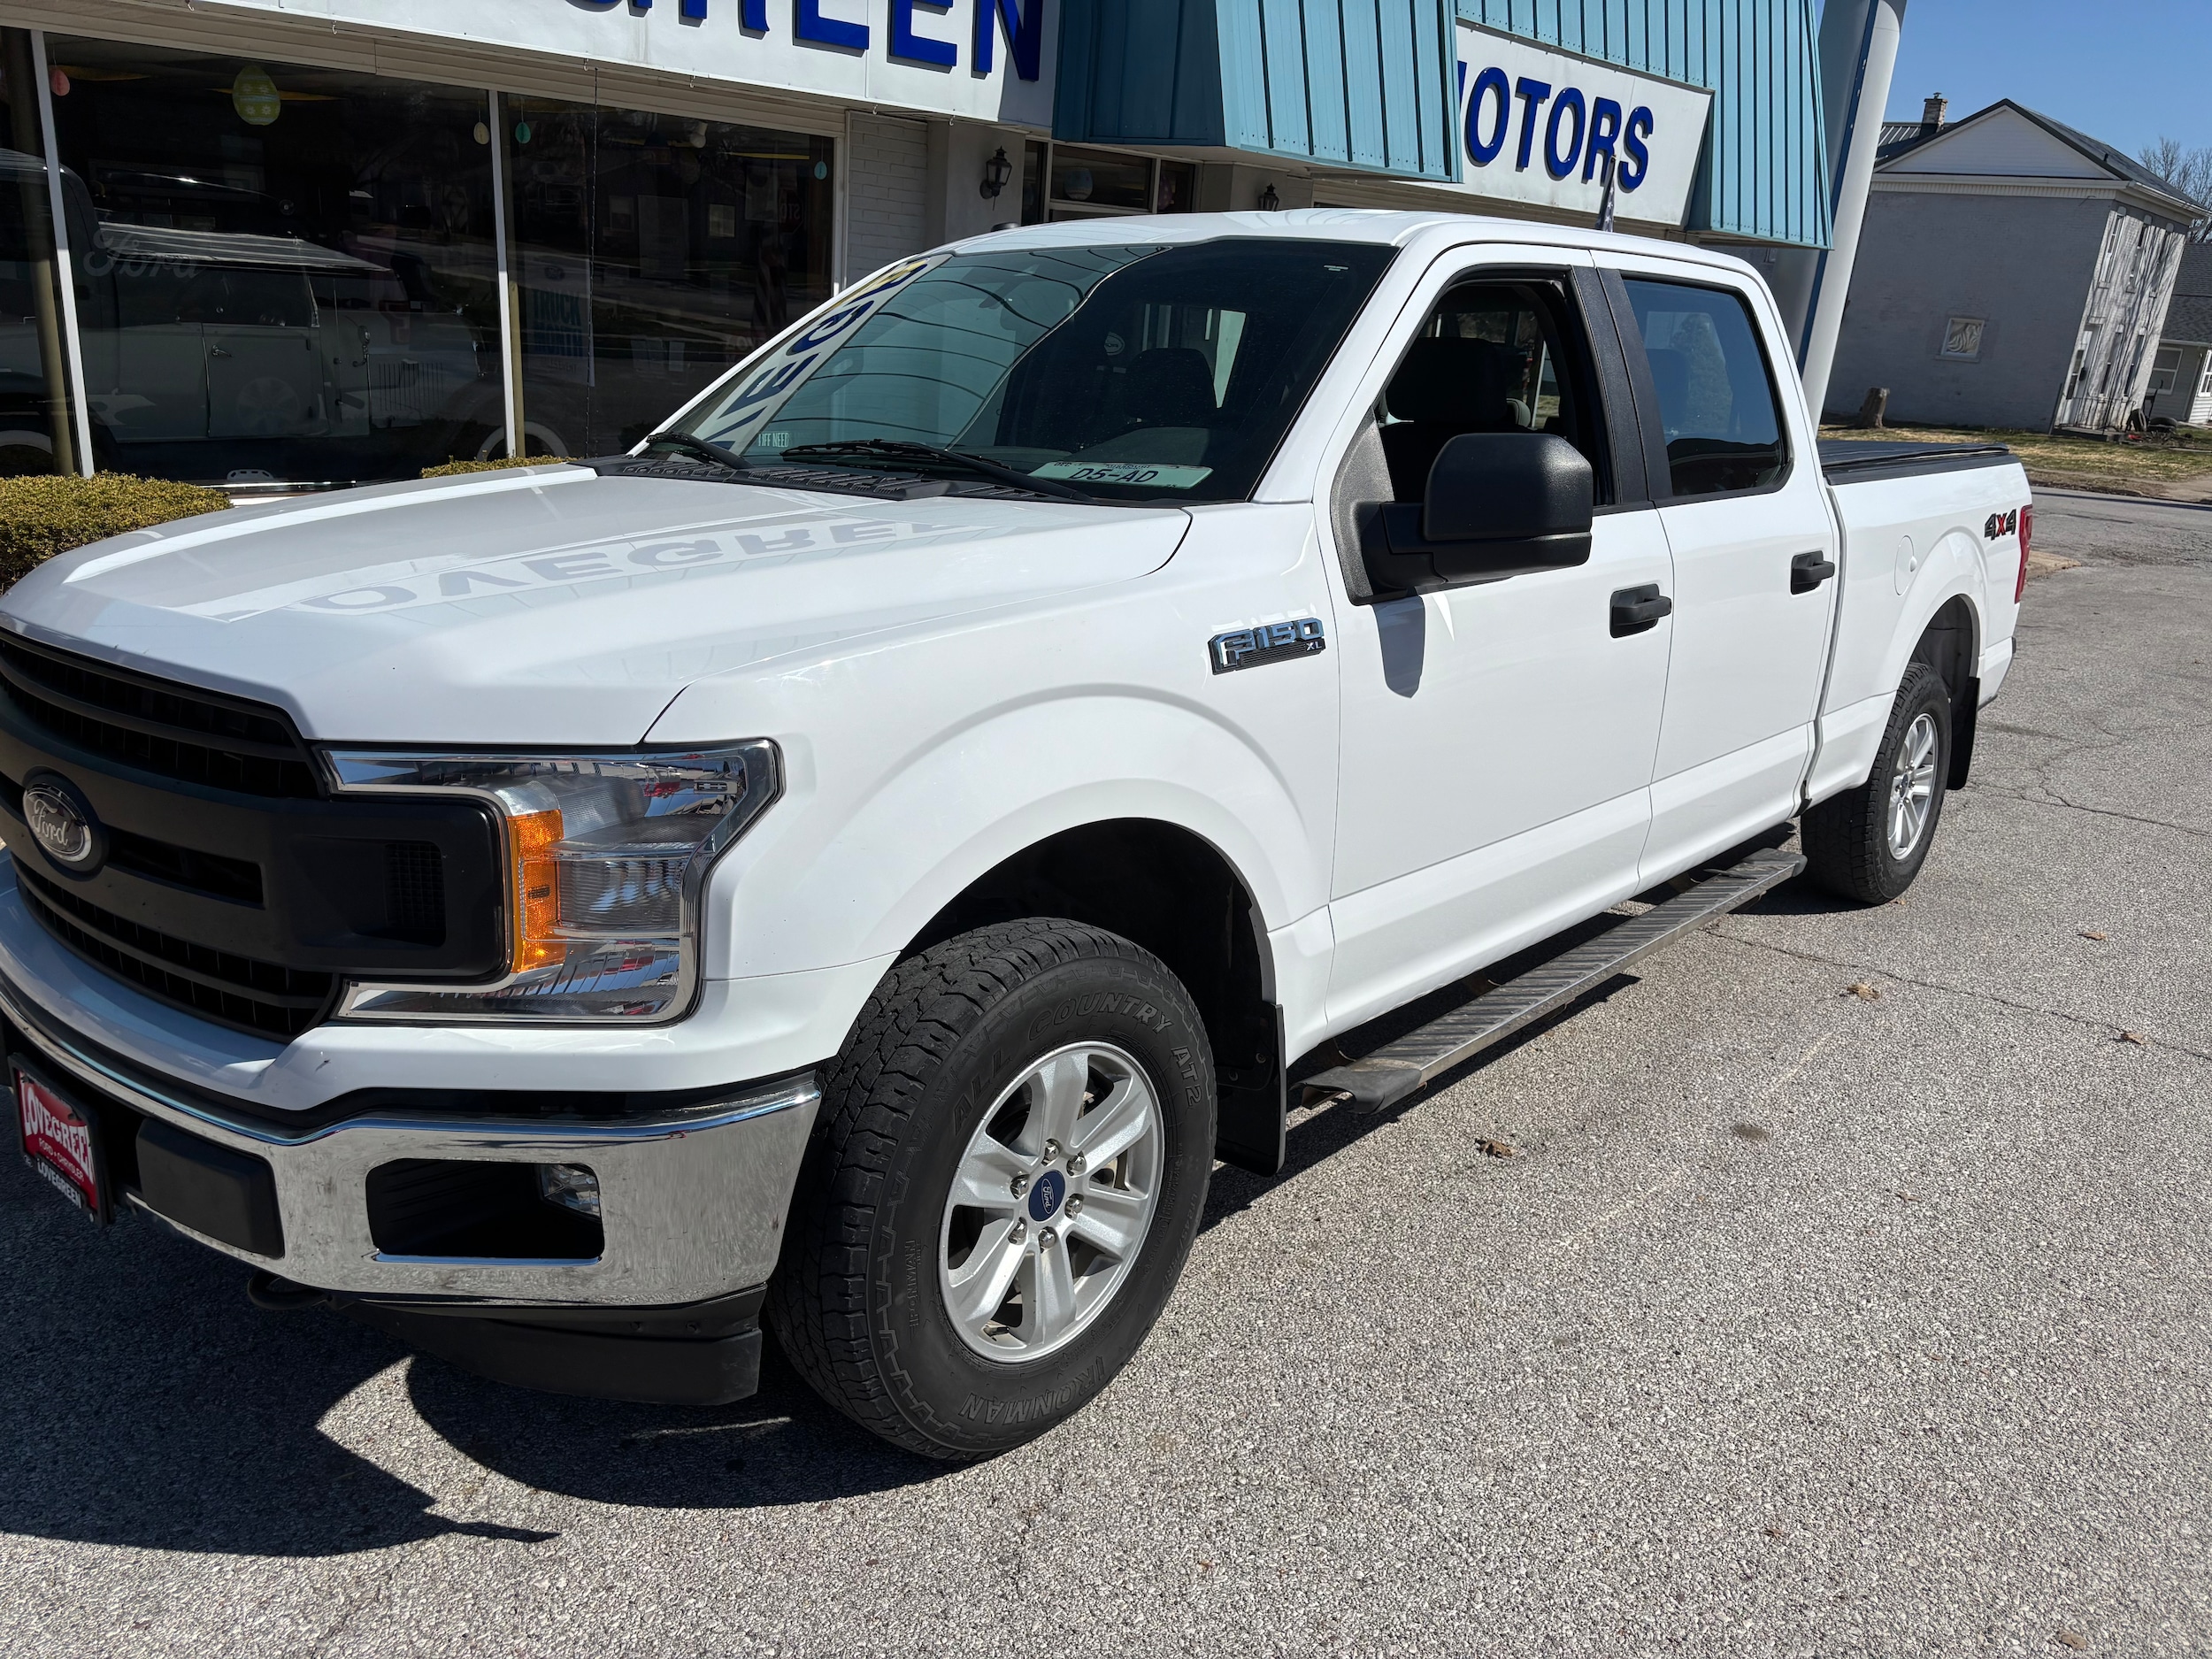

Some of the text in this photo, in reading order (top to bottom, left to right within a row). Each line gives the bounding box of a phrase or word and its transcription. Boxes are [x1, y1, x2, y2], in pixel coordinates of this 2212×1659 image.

[1458, 60, 1654, 192] OTORS
[83, 229, 206, 280] Ford
[1306, 641, 1323, 651] XL
[32, 799, 68, 846] Ford
[952, 992, 1203, 1137] ALL COUNTRY AT2
[37, 1158, 82, 1209] LOVEGREEN
[1042, 1186, 1053, 1209] Ford
[958, 1355, 1107, 1426] IRONMAN
